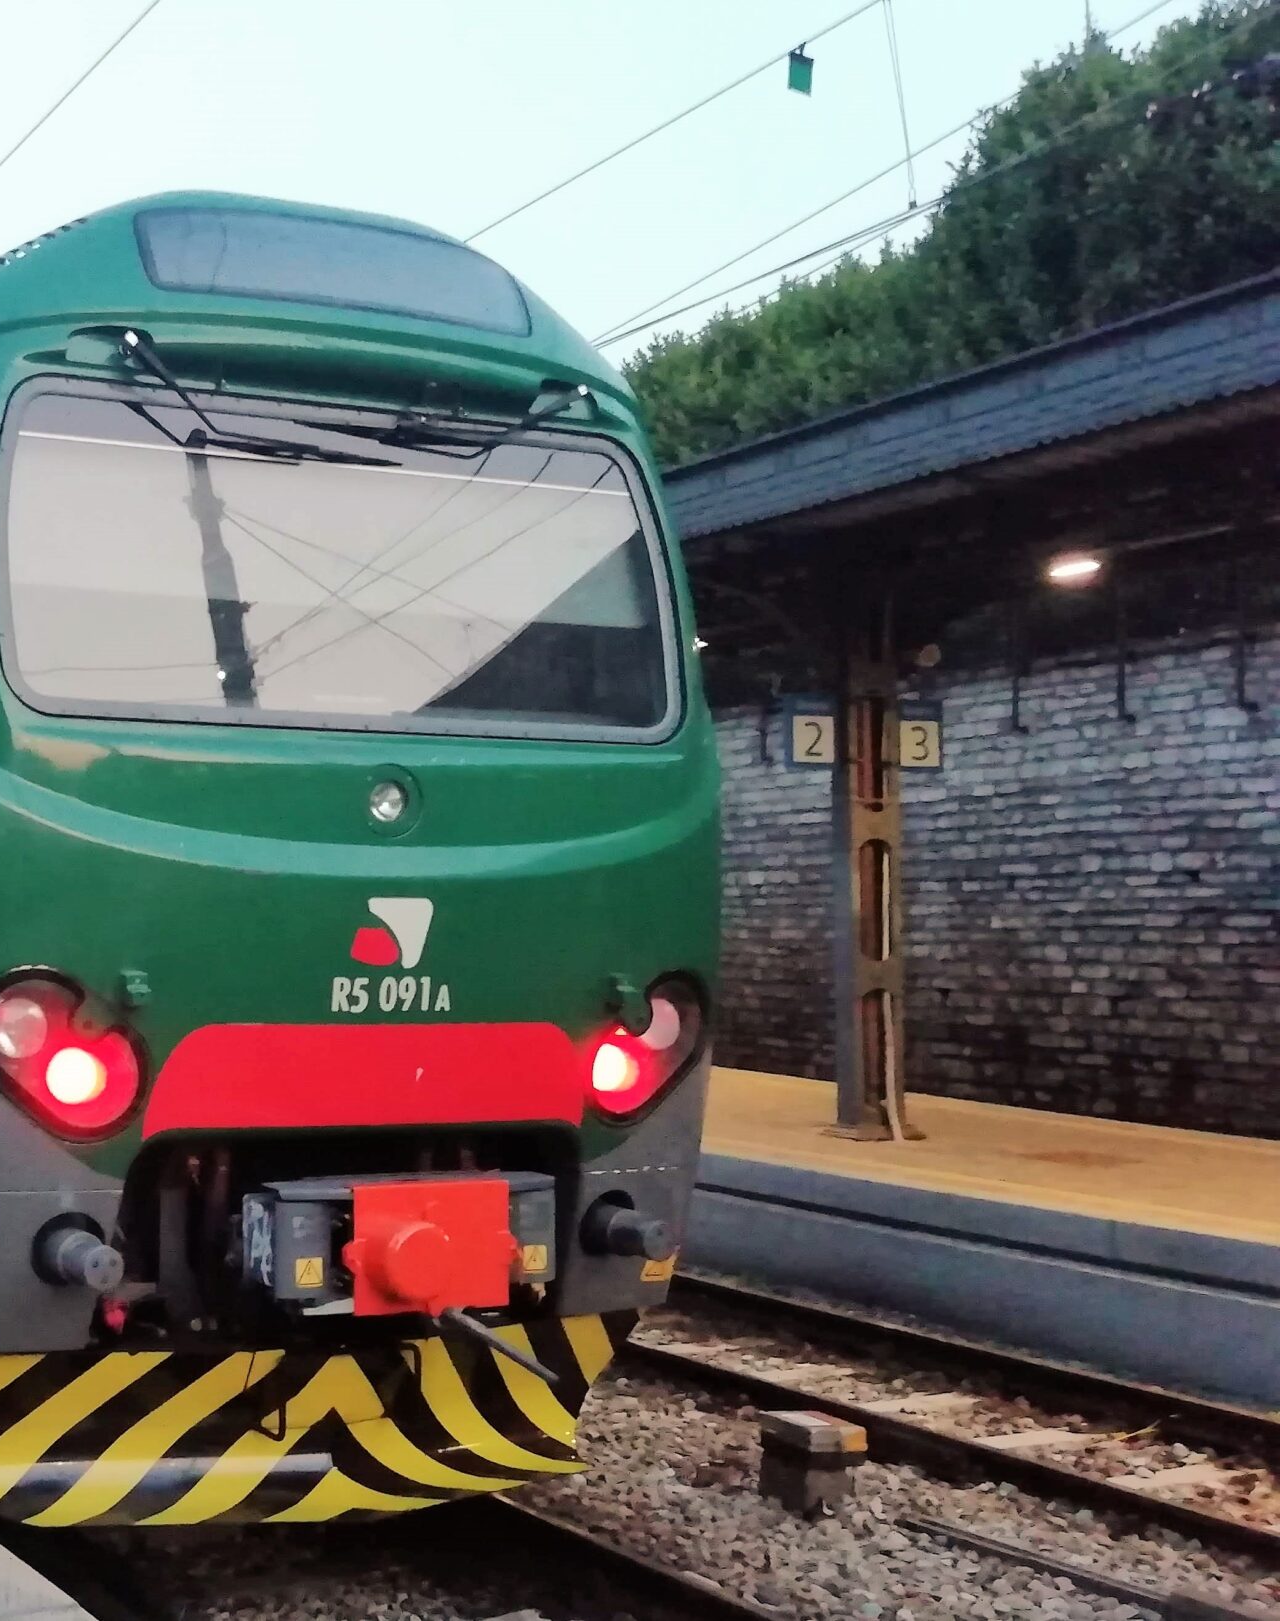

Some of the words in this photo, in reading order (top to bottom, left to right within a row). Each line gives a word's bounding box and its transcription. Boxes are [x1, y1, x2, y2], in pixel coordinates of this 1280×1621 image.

[804, 721, 824, 757] 2
[911, 726, 929, 761] 3
[331, 976, 370, 1014] R5
